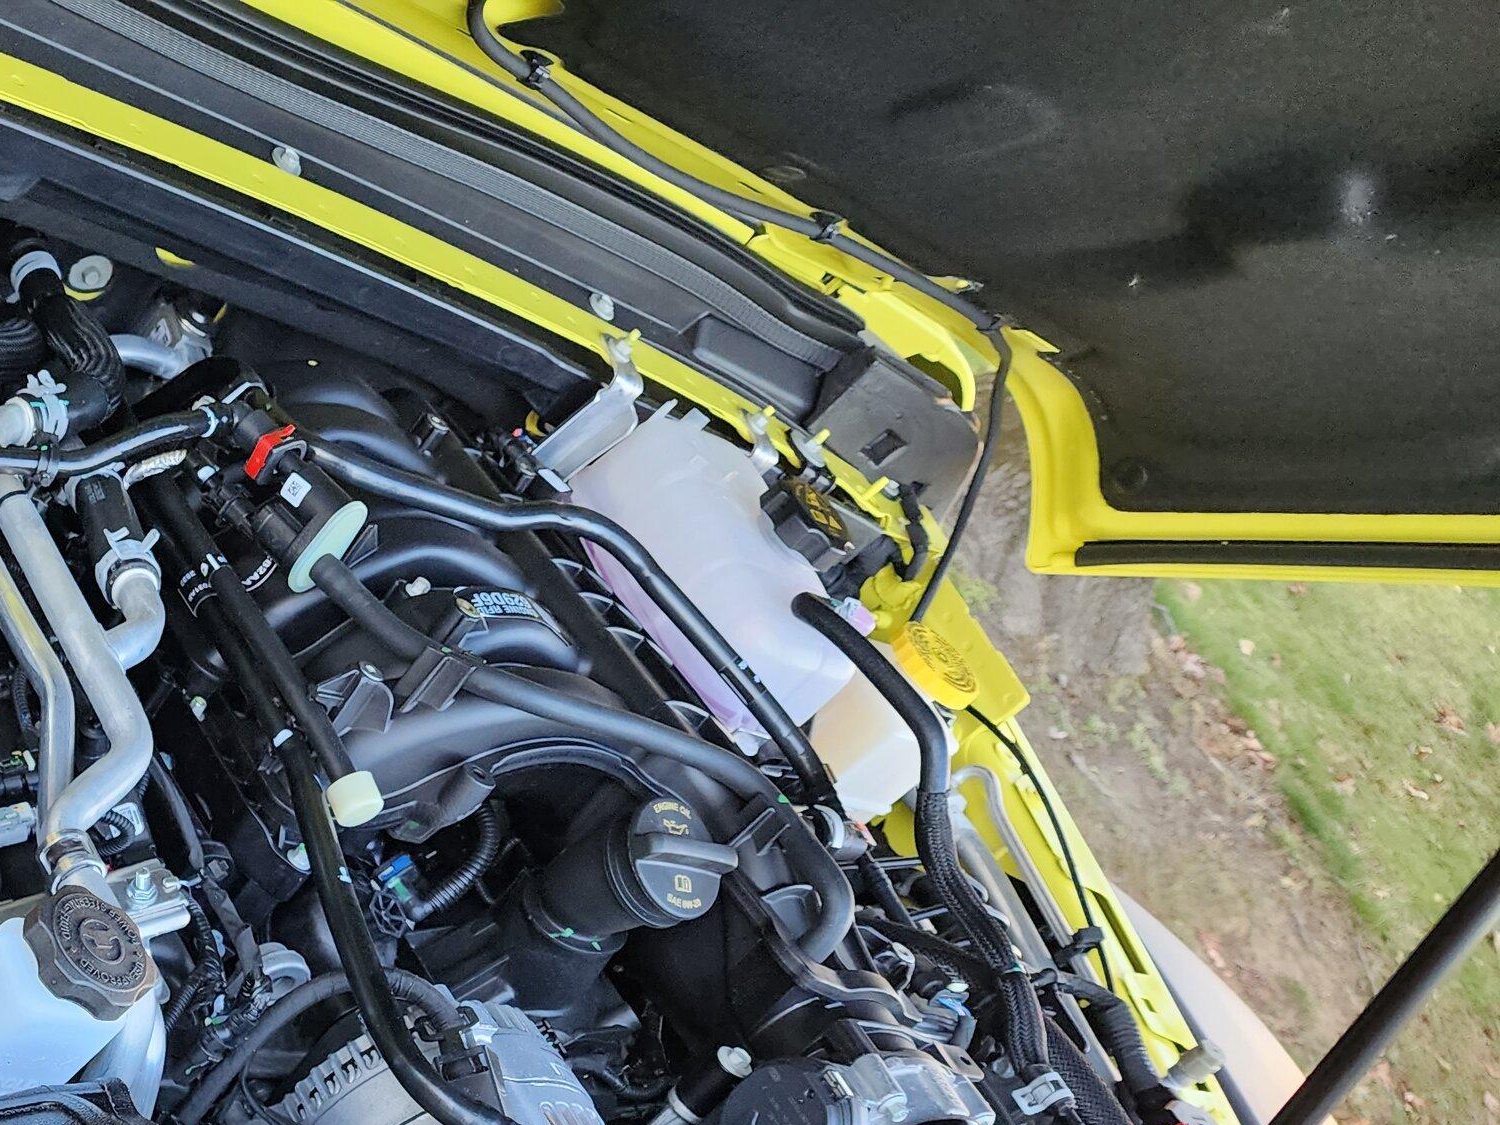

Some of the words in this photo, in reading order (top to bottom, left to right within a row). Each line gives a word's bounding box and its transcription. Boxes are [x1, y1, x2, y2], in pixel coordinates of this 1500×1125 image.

[476, 604, 503, 614] RFID
[653, 801, 680, 814] ENGINE
[679, 805, 693, 820] OIL
[666, 892, 682, 908] SAE
[108, 908, 141, 946] POWER
[80, 958, 132, 986] APPROVED
